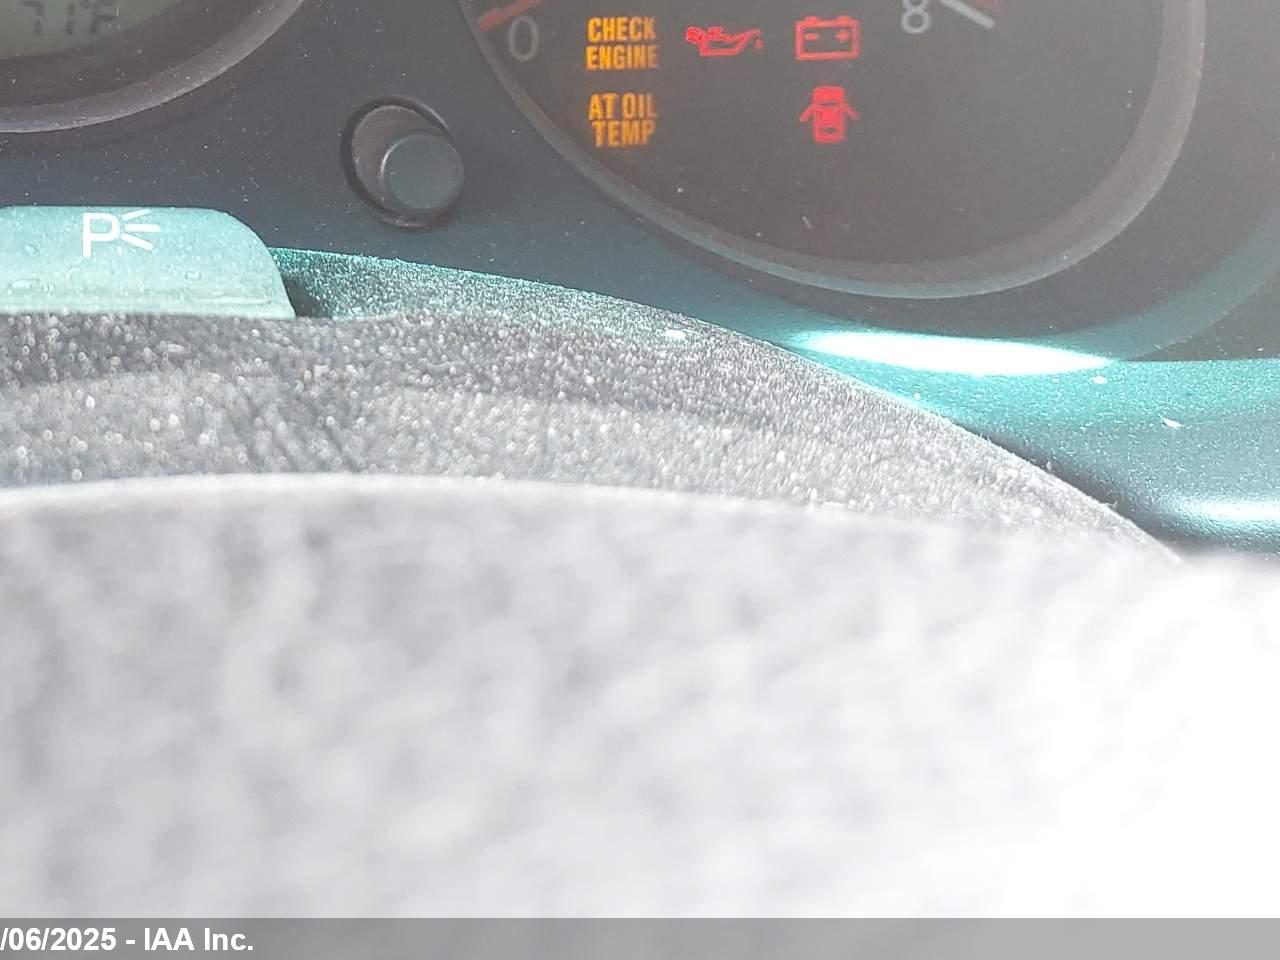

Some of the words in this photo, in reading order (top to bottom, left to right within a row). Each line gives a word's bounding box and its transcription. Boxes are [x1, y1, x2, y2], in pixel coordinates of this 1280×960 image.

[507, 16, 539, 60] 0
[587, 16, 658, 43] CHECK
[586, 44, 659, 71] ENGINE
[587, 94, 618, 119] AT
[623, 93, 657, 119] OIL
[591, 120, 656, 147] TEMP
[81, 212, 120, 257] P
